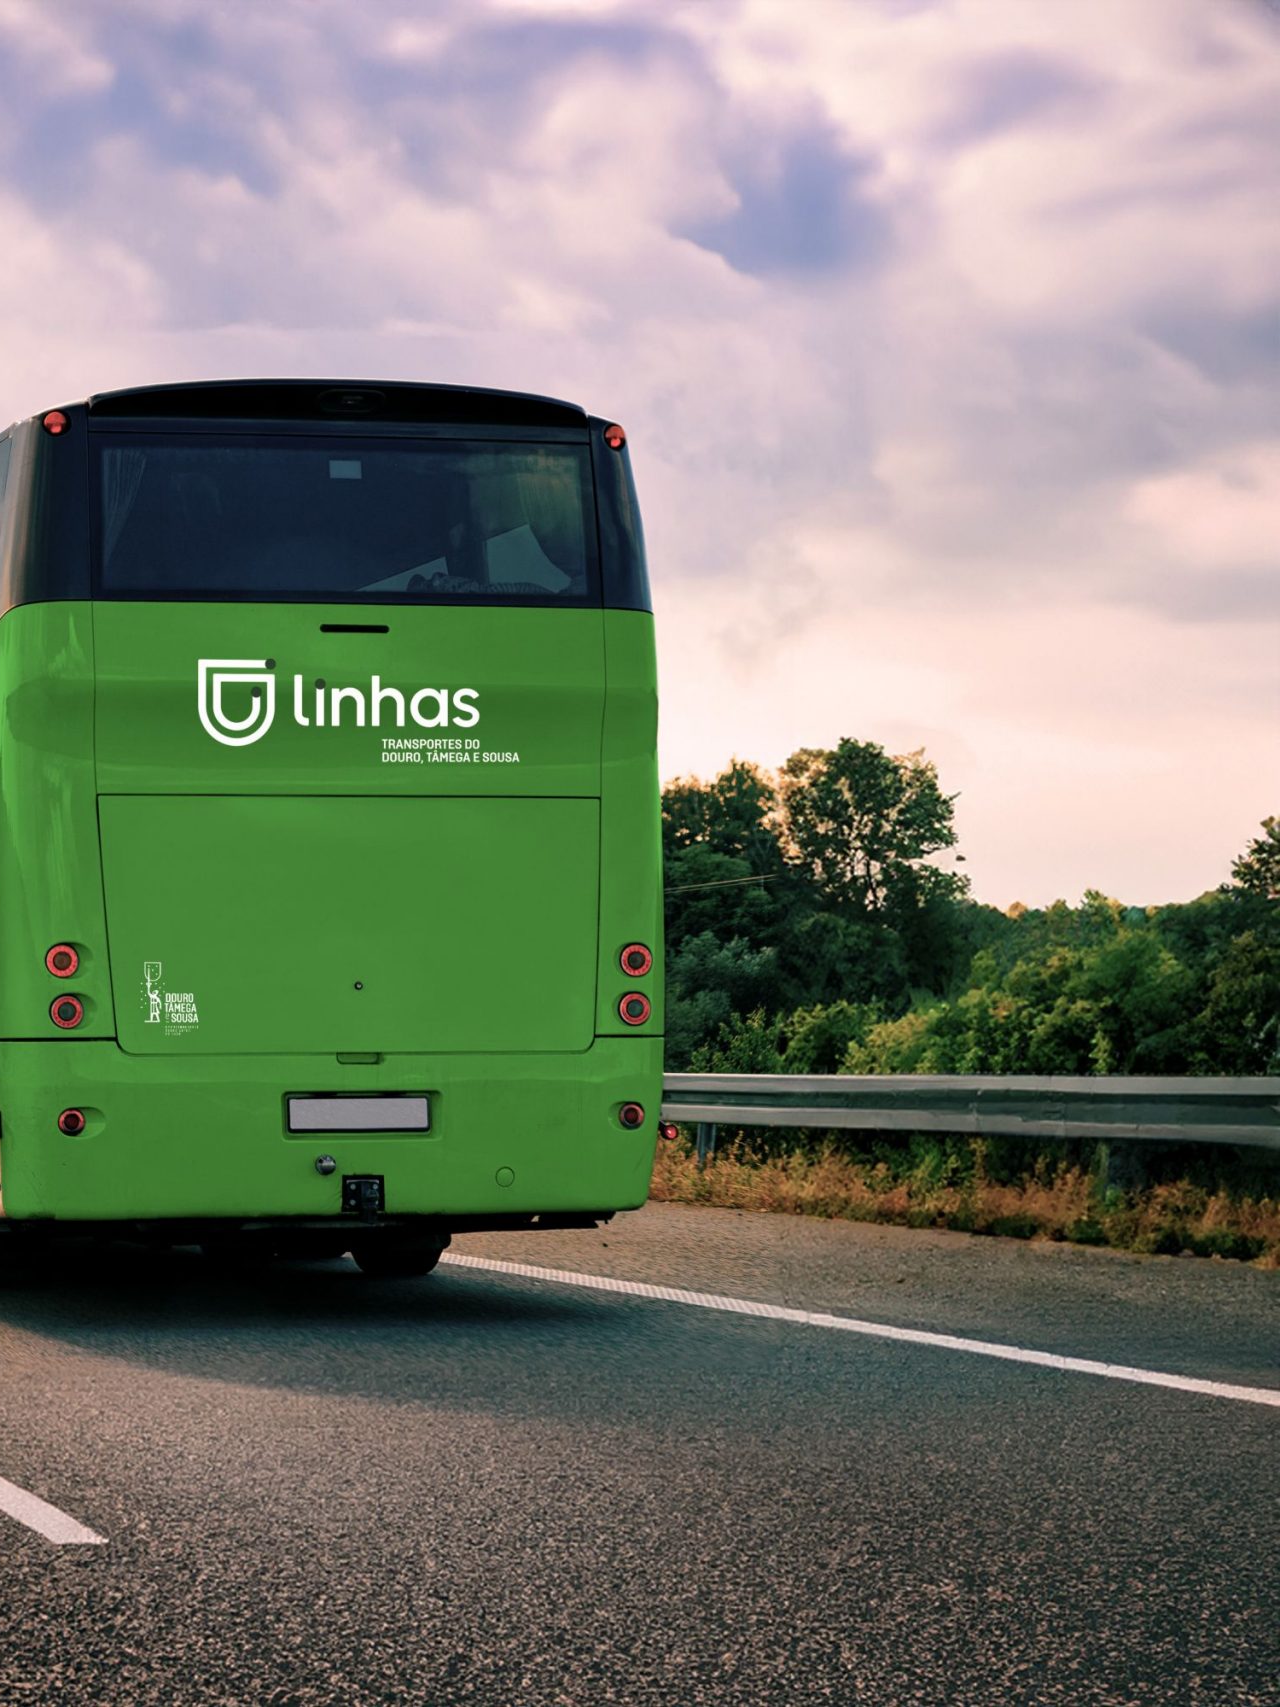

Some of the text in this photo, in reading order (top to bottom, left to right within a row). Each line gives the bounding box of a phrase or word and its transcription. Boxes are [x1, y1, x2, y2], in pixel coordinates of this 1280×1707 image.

[294, 674, 480, 728] linhas
[381, 739, 480, 750] TRANSPORTES DO
[381, 750, 520, 764] DOURO, TÂMEGA E SOUSA
[165, 993, 194, 1002] DOURO
[171, 1012, 199, 1023] SOUSA
